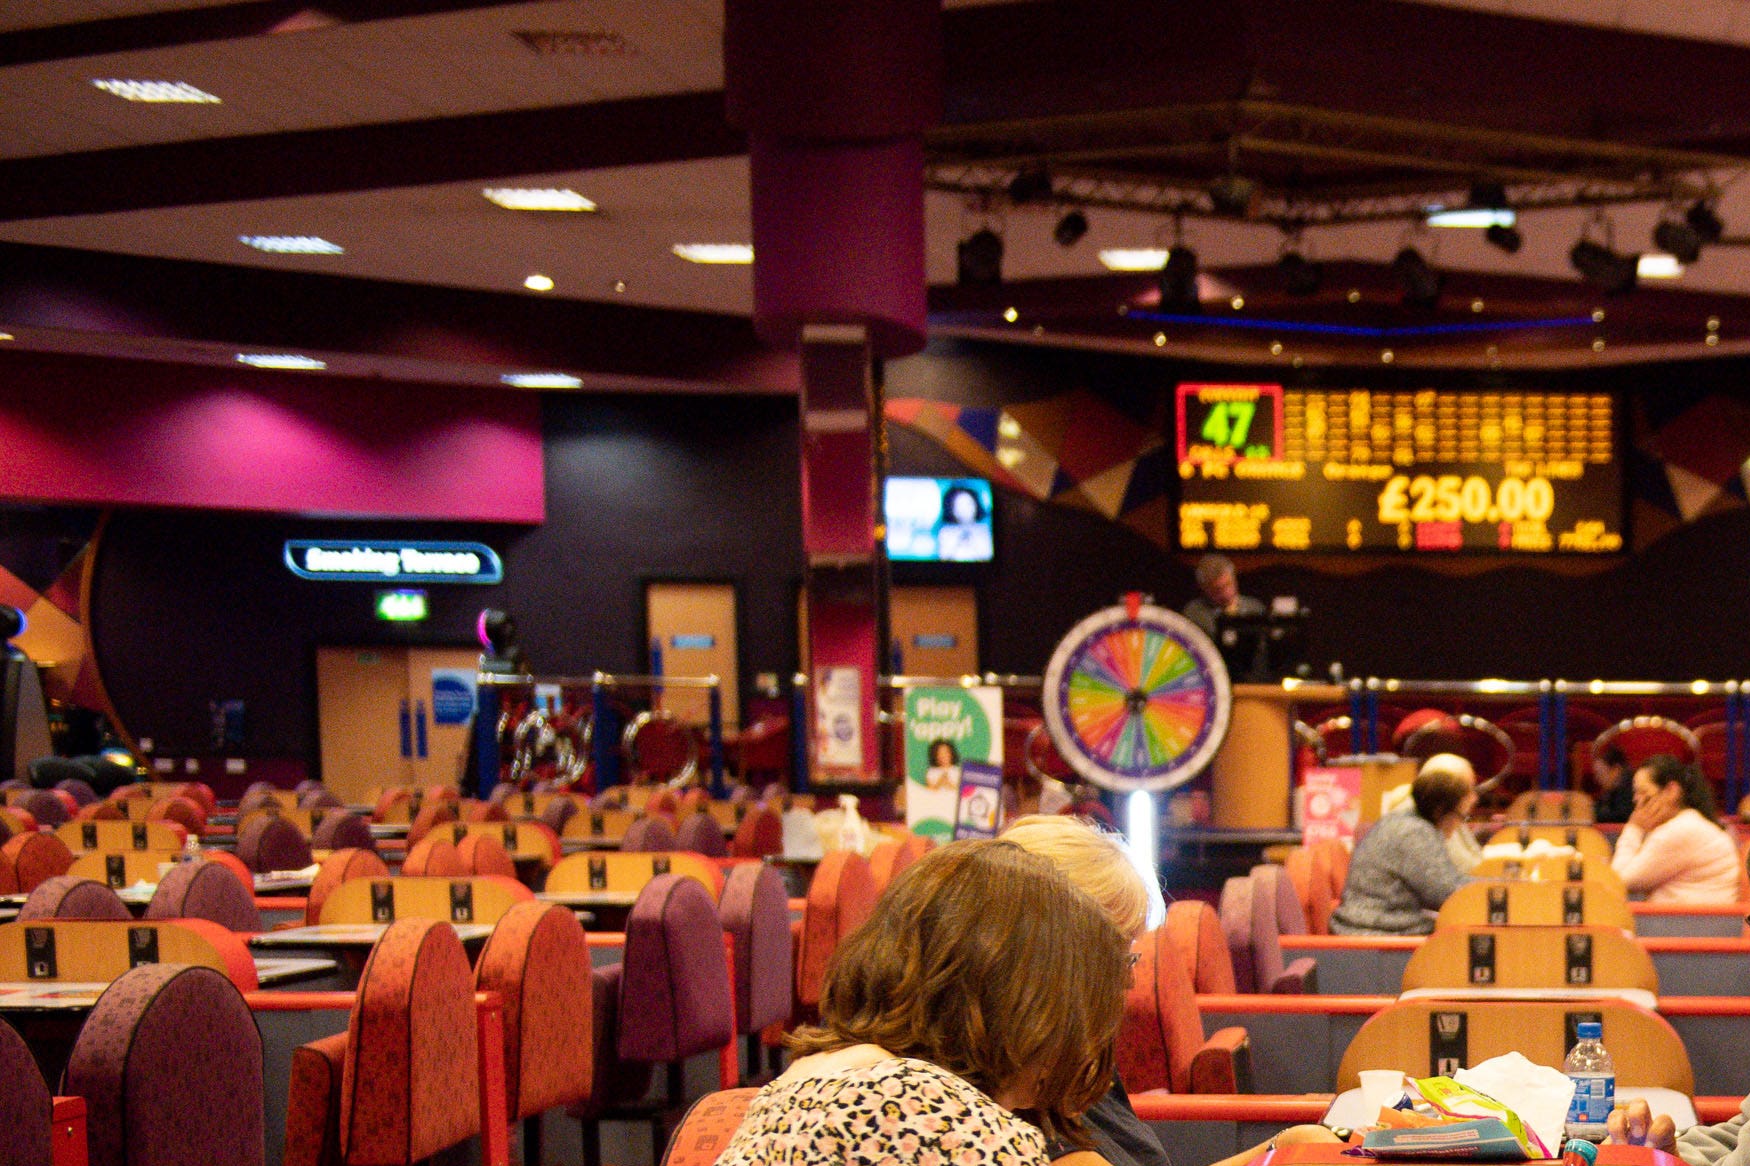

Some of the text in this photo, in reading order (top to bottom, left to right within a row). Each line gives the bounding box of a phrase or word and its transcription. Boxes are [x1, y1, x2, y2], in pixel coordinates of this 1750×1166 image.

[1202, 401, 1256, 449] 47
[1378, 474, 1555, 524] £250.00
[917, 698, 963, 720] Play
